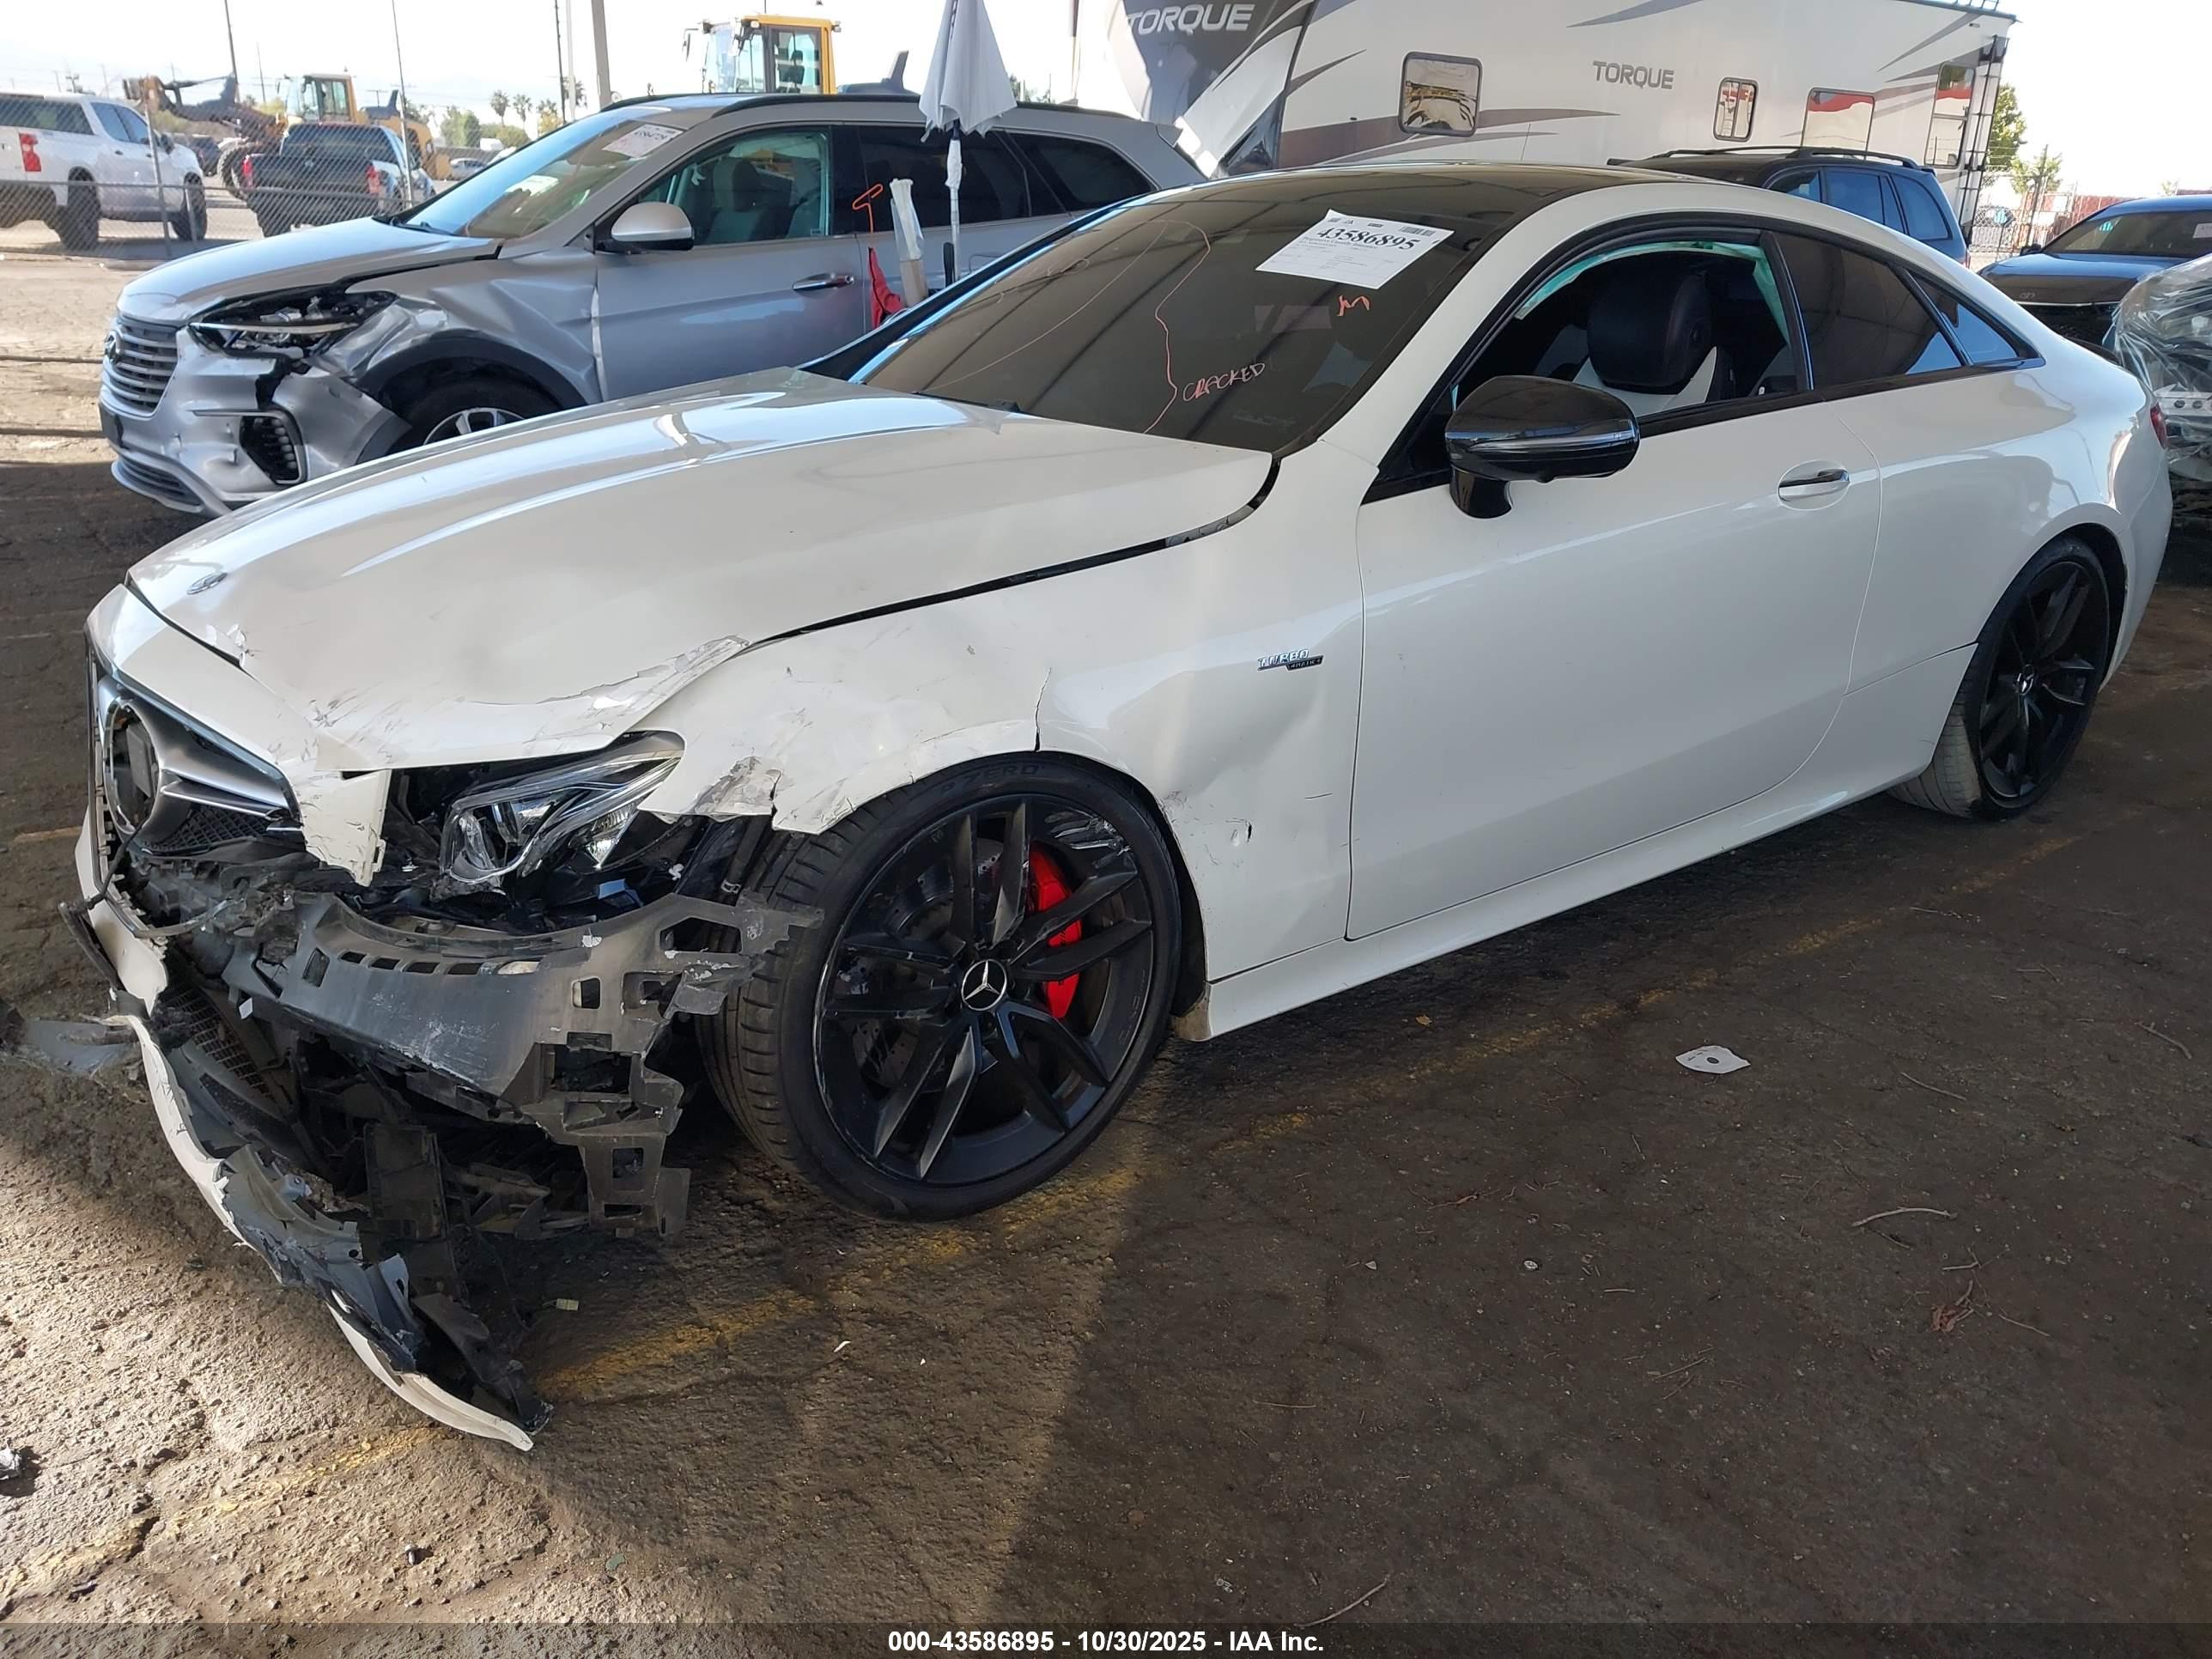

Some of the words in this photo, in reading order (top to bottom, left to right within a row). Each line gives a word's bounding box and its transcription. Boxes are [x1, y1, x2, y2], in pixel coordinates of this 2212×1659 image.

[1127, 3, 1255, 35] TORQUE
[1593, 60, 1674, 89] TORQUE
[1317, 228, 1420, 250] 43586895
[1183, 362, 1266, 401] CRACKED
[1258, 649, 1310, 667] TURBO
